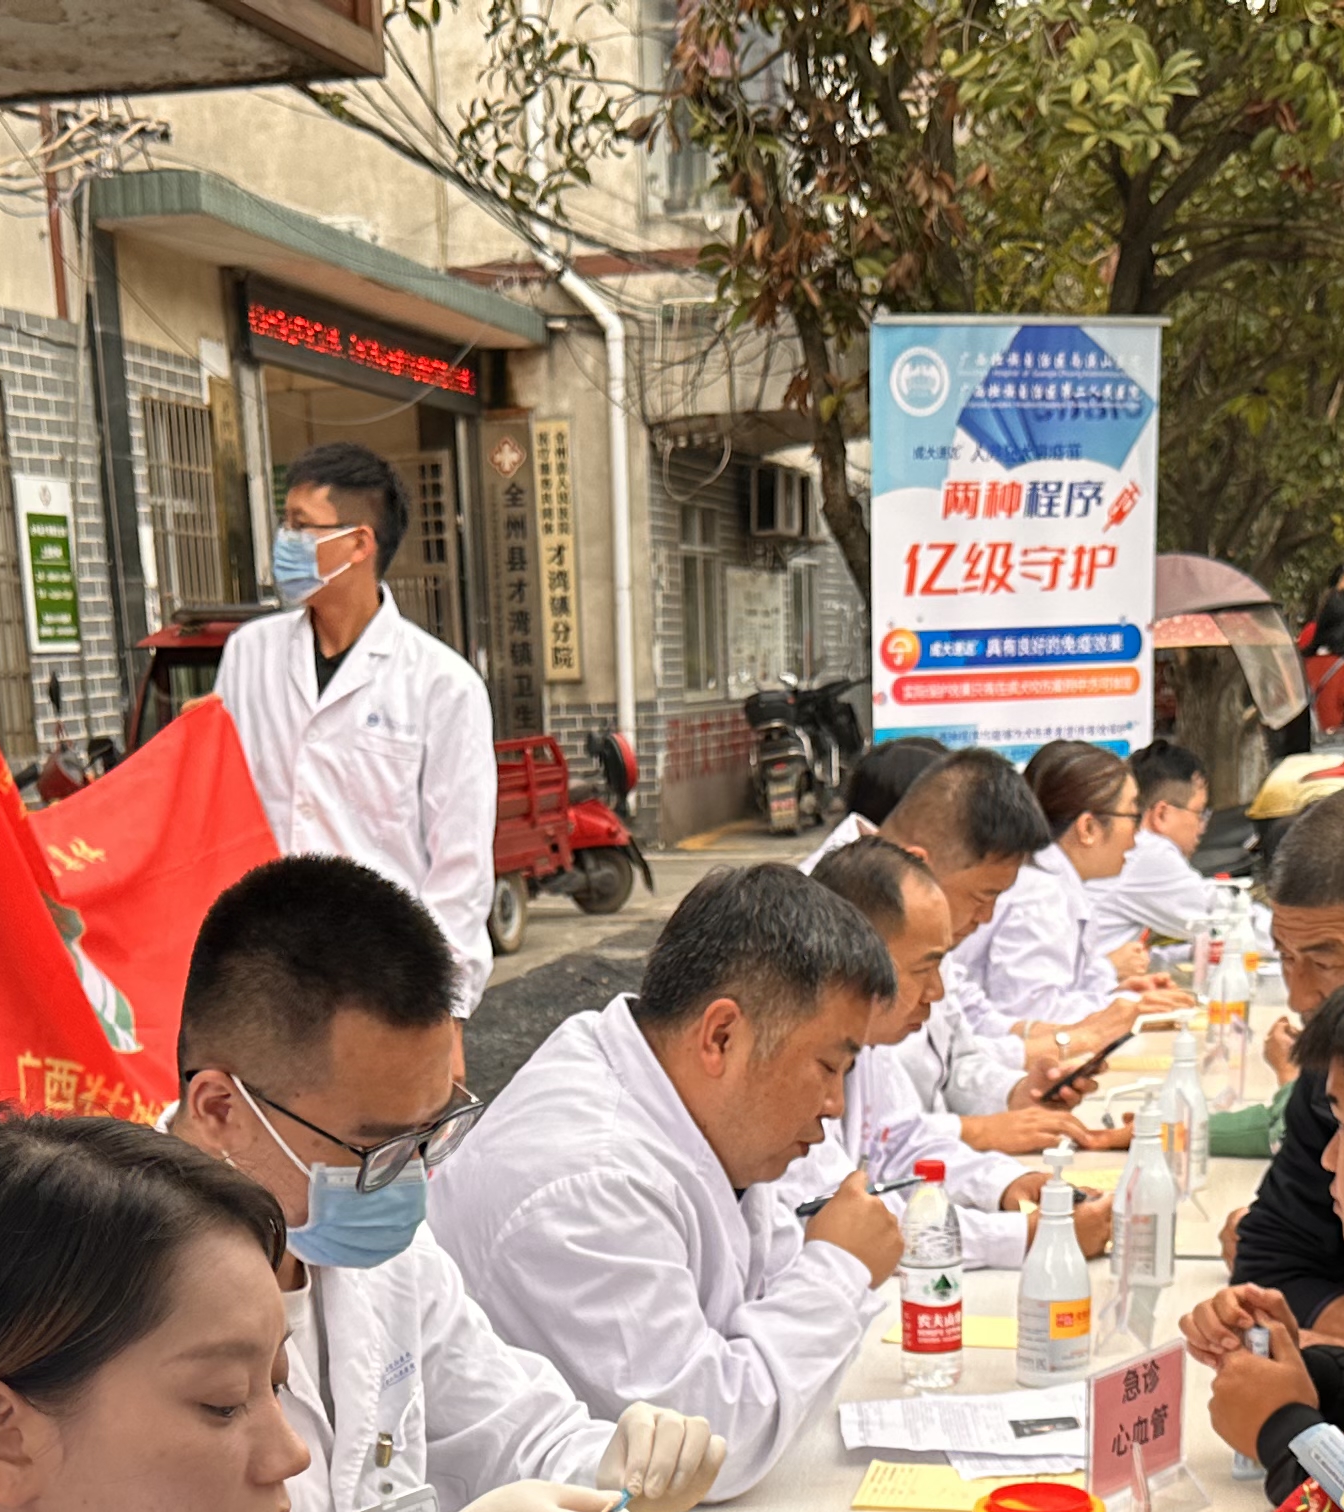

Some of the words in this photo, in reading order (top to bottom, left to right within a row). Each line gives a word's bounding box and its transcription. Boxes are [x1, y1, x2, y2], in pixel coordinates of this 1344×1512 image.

[942, 480, 1104, 519] 两种程序
[904, 542, 1118, 596] 亿级守护
[17, 1050, 173, 1124] 广西壮
[1122, 1360, 1160, 1404] 急诊
[1112, 1404, 1168, 1456] 心血管
